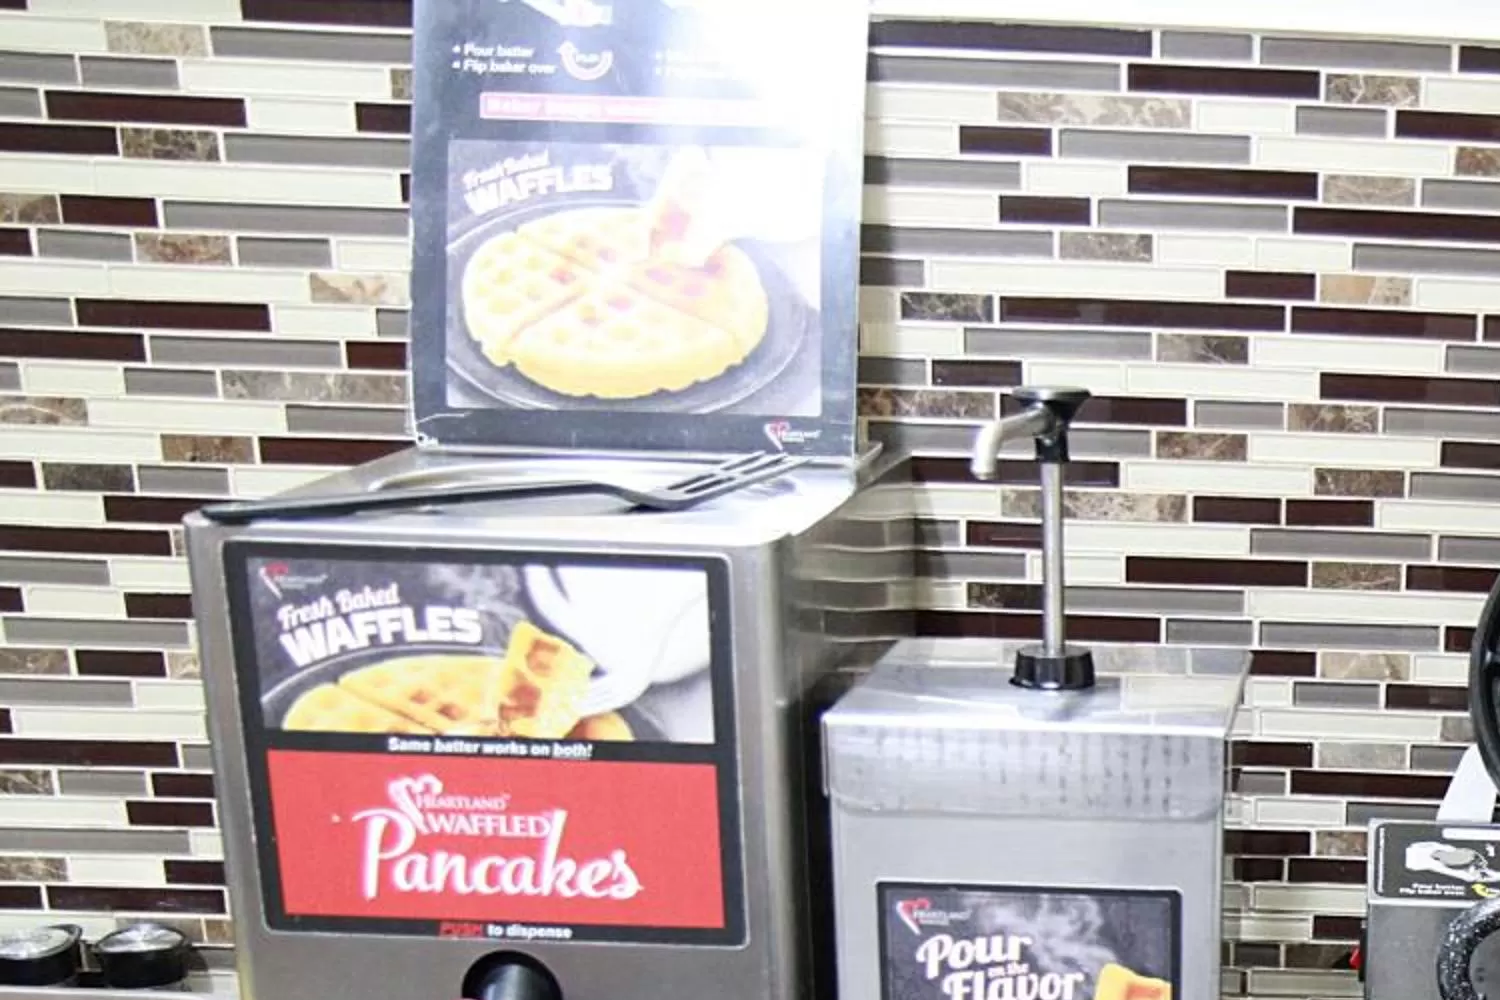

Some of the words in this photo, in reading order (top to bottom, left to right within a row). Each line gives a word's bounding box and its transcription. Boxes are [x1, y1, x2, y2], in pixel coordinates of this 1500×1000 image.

[464, 165, 612, 216] WAFFLES
[277, 596, 335, 630] Fresh
[280, 605, 482, 667] WAFFLES
[388, 737, 432, 751] Same
[434, 738, 480, 754] batter
[480, 742, 527, 756] works
[530, 745, 550, 757] on
[552, 742, 593, 759] both!
[426, 813, 551, 838] WAFFLED
[351, 807, 644, 901] Pancakes
[487, 923, 503, 937] to
[506, 923, 573, 940] dispense
[916, 934, 1032, 980] Pour
